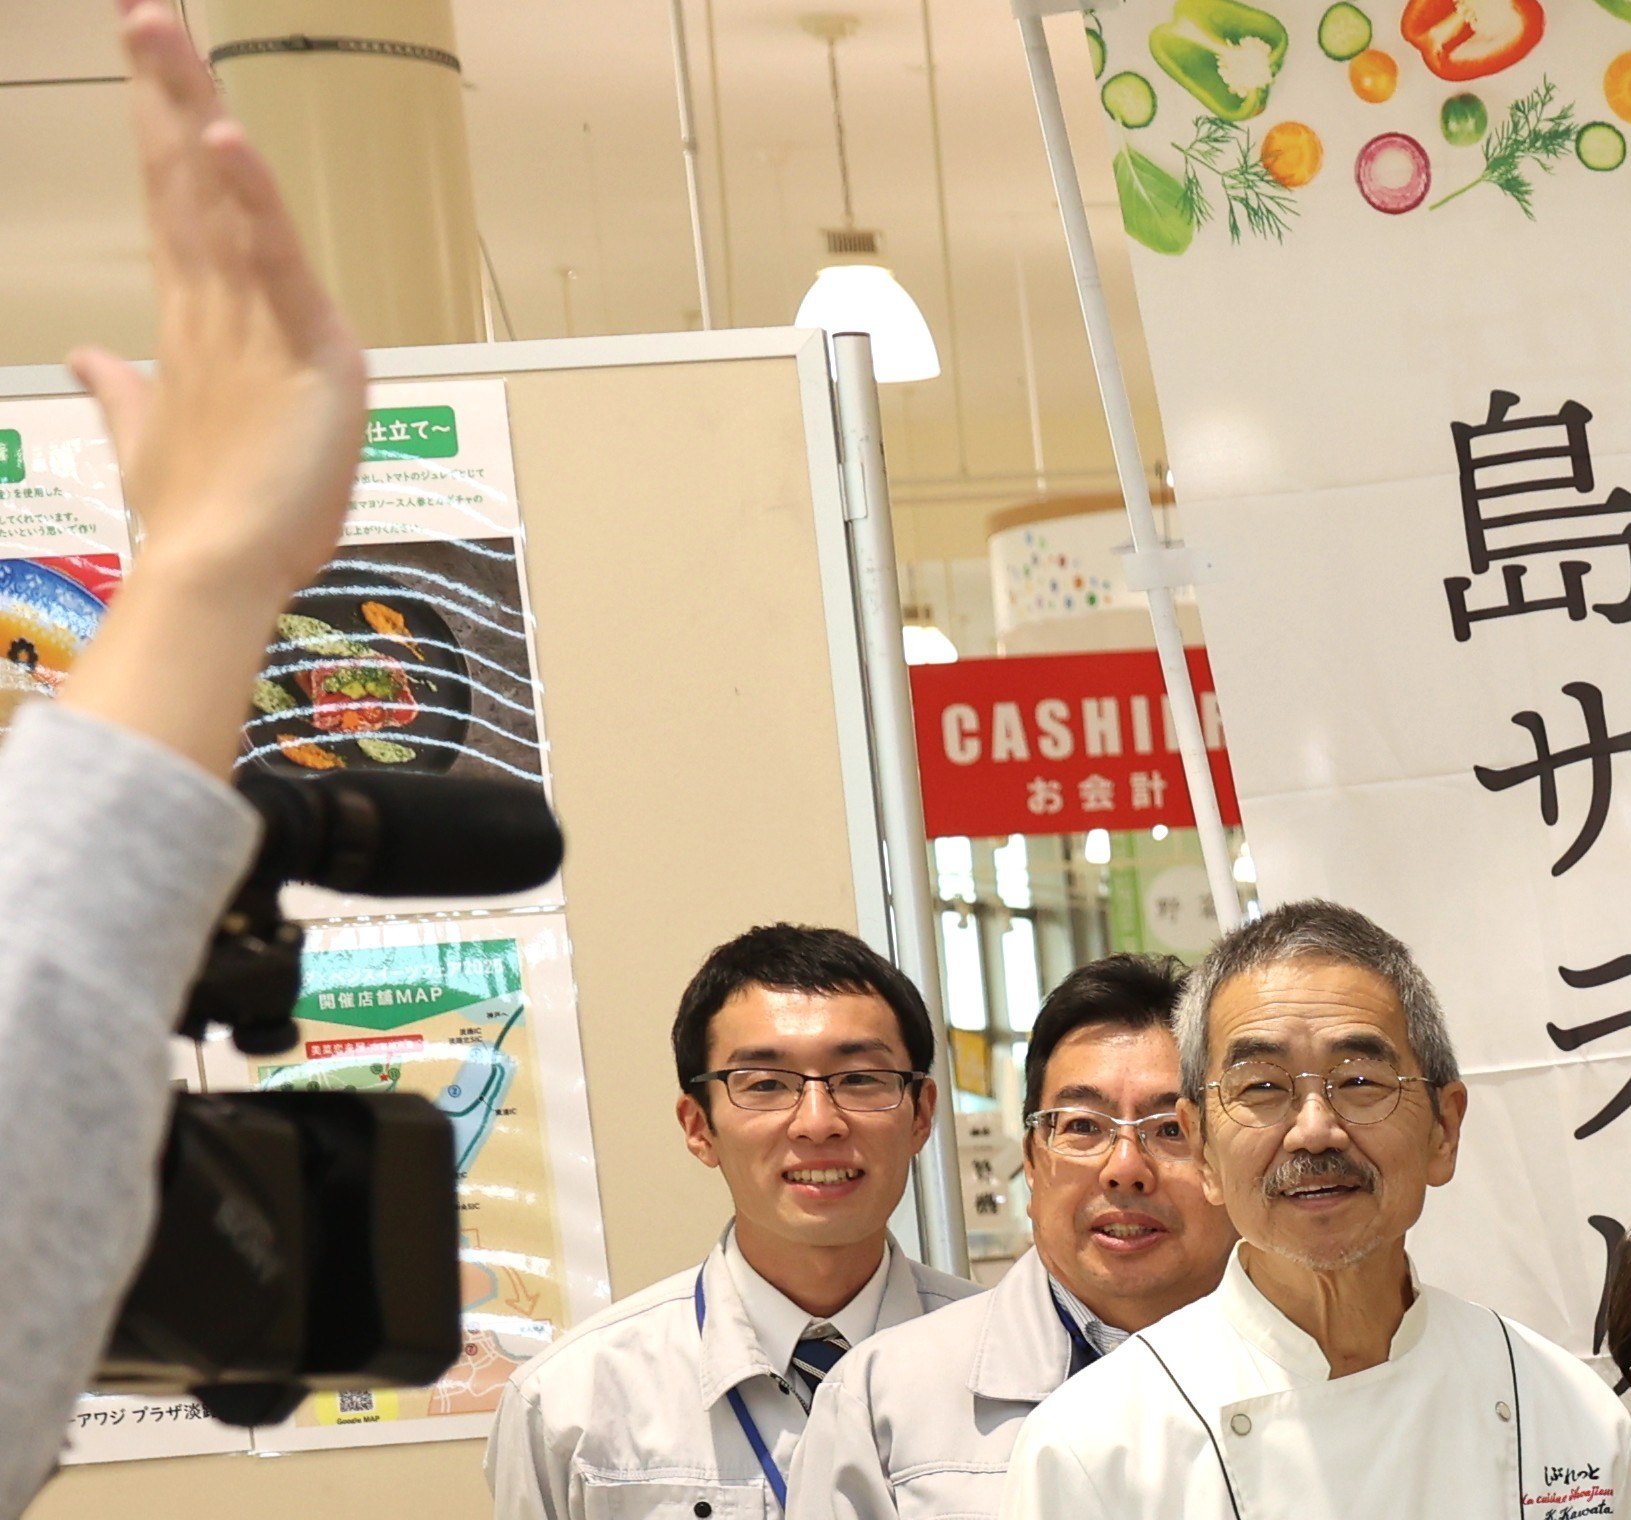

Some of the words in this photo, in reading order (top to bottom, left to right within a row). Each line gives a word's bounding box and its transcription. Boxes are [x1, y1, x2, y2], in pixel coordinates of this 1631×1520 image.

[1025, 770, 1168, 815] お会計
[318, 987, 443, 1011] 開催店舗MAP
